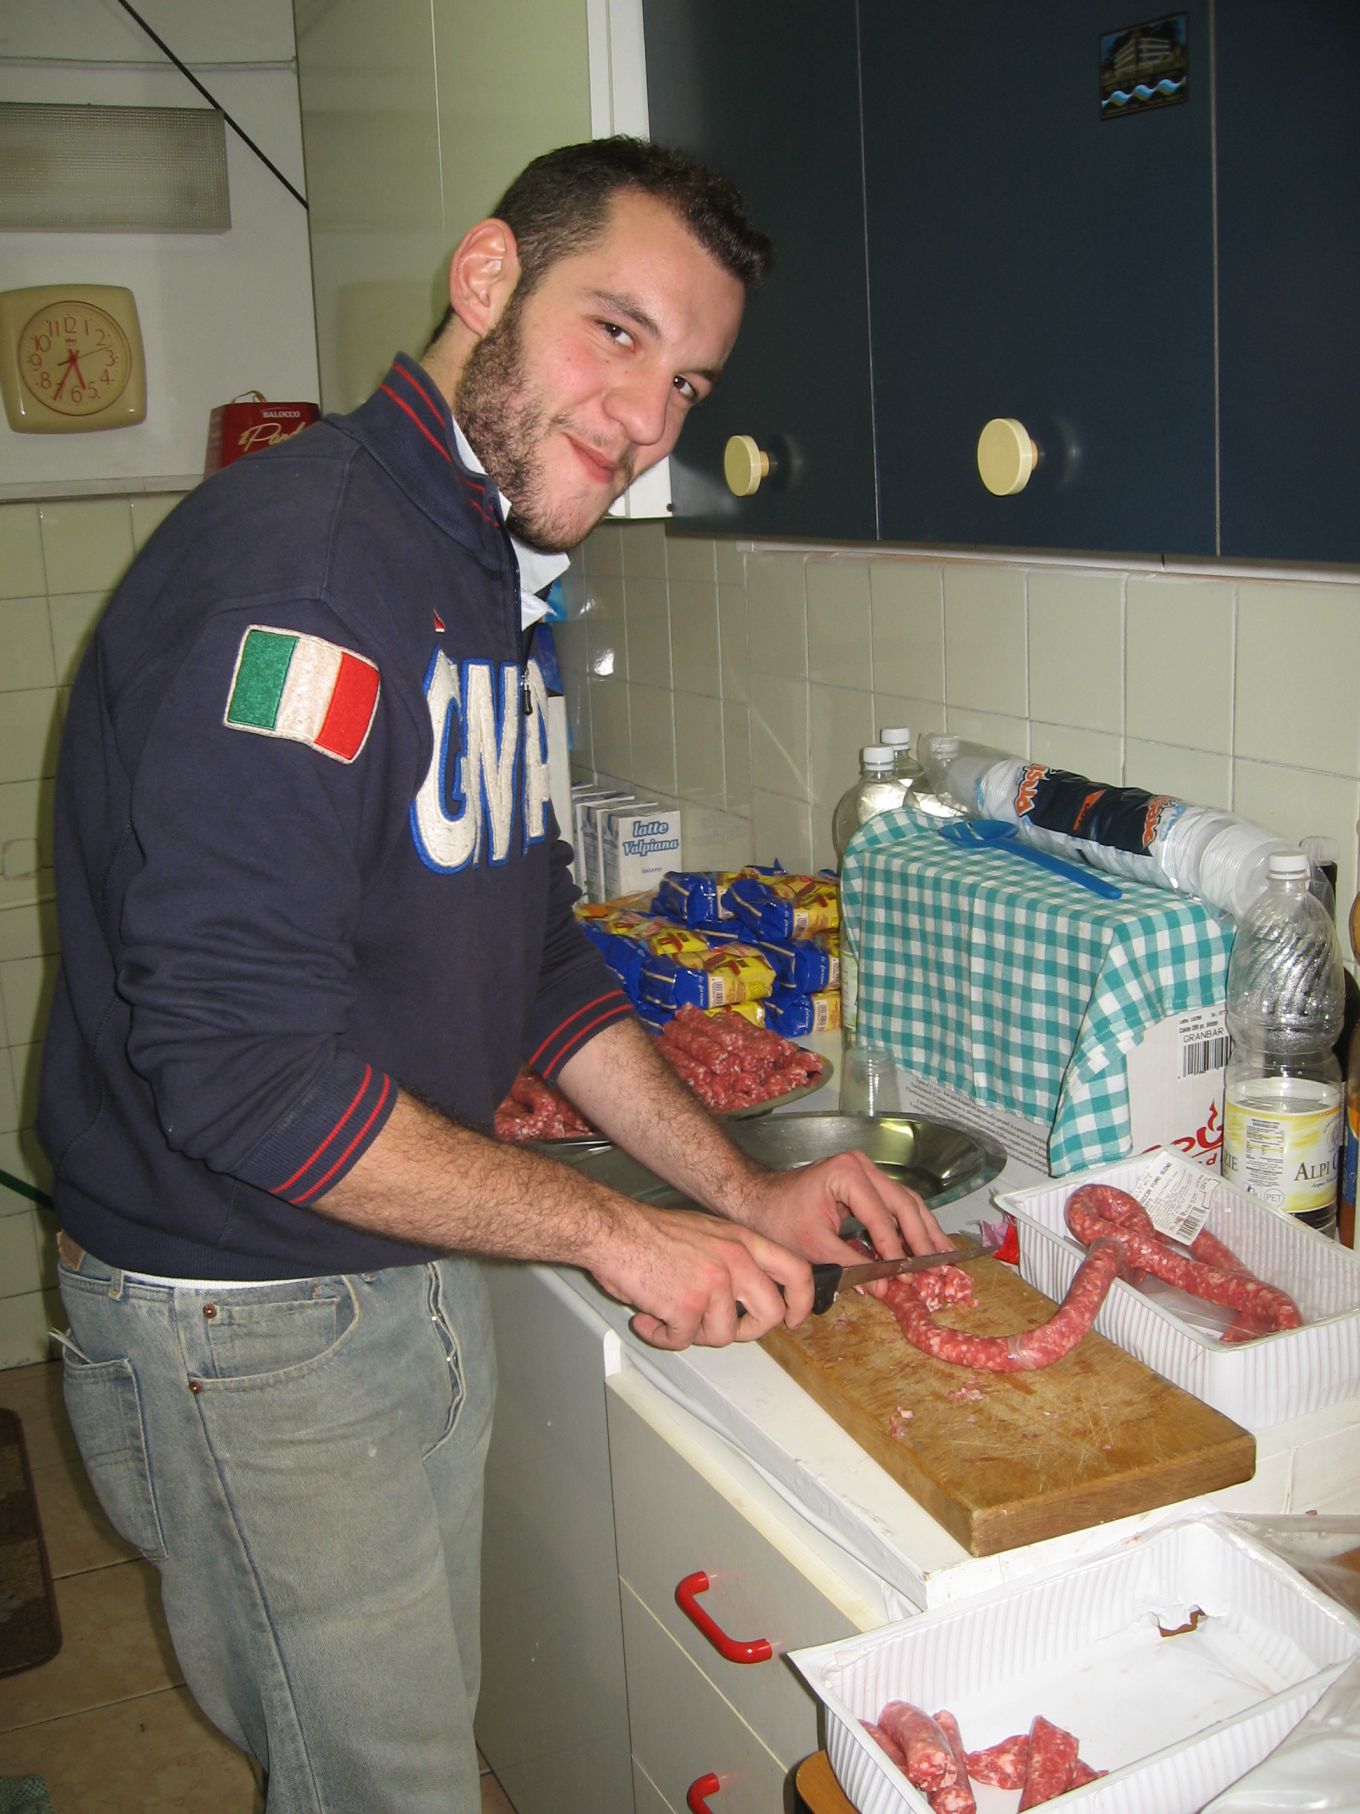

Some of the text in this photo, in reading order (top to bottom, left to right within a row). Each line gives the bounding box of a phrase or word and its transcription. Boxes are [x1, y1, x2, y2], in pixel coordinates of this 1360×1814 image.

[34, 334, 51, 352] 10
[96, 329, 106, 346] 2
[30, 353, 42, 371] 9
[105, 348, 116, 367] 3
[40, 371, 51, 390] 8
[100, 369, 110, 385] 4
[71, 385, 82, 404] 6
[88, 382, 99, 399] 5
[633, 820, 669, 838] latte
[622, 839, 679, 857] Valpiana
[1183, 1027, 1224, 1043] GRANBAR
[1294, 1161, 1330, 1181] ALPI
[1265, 1192, 1282, 1202] PET
